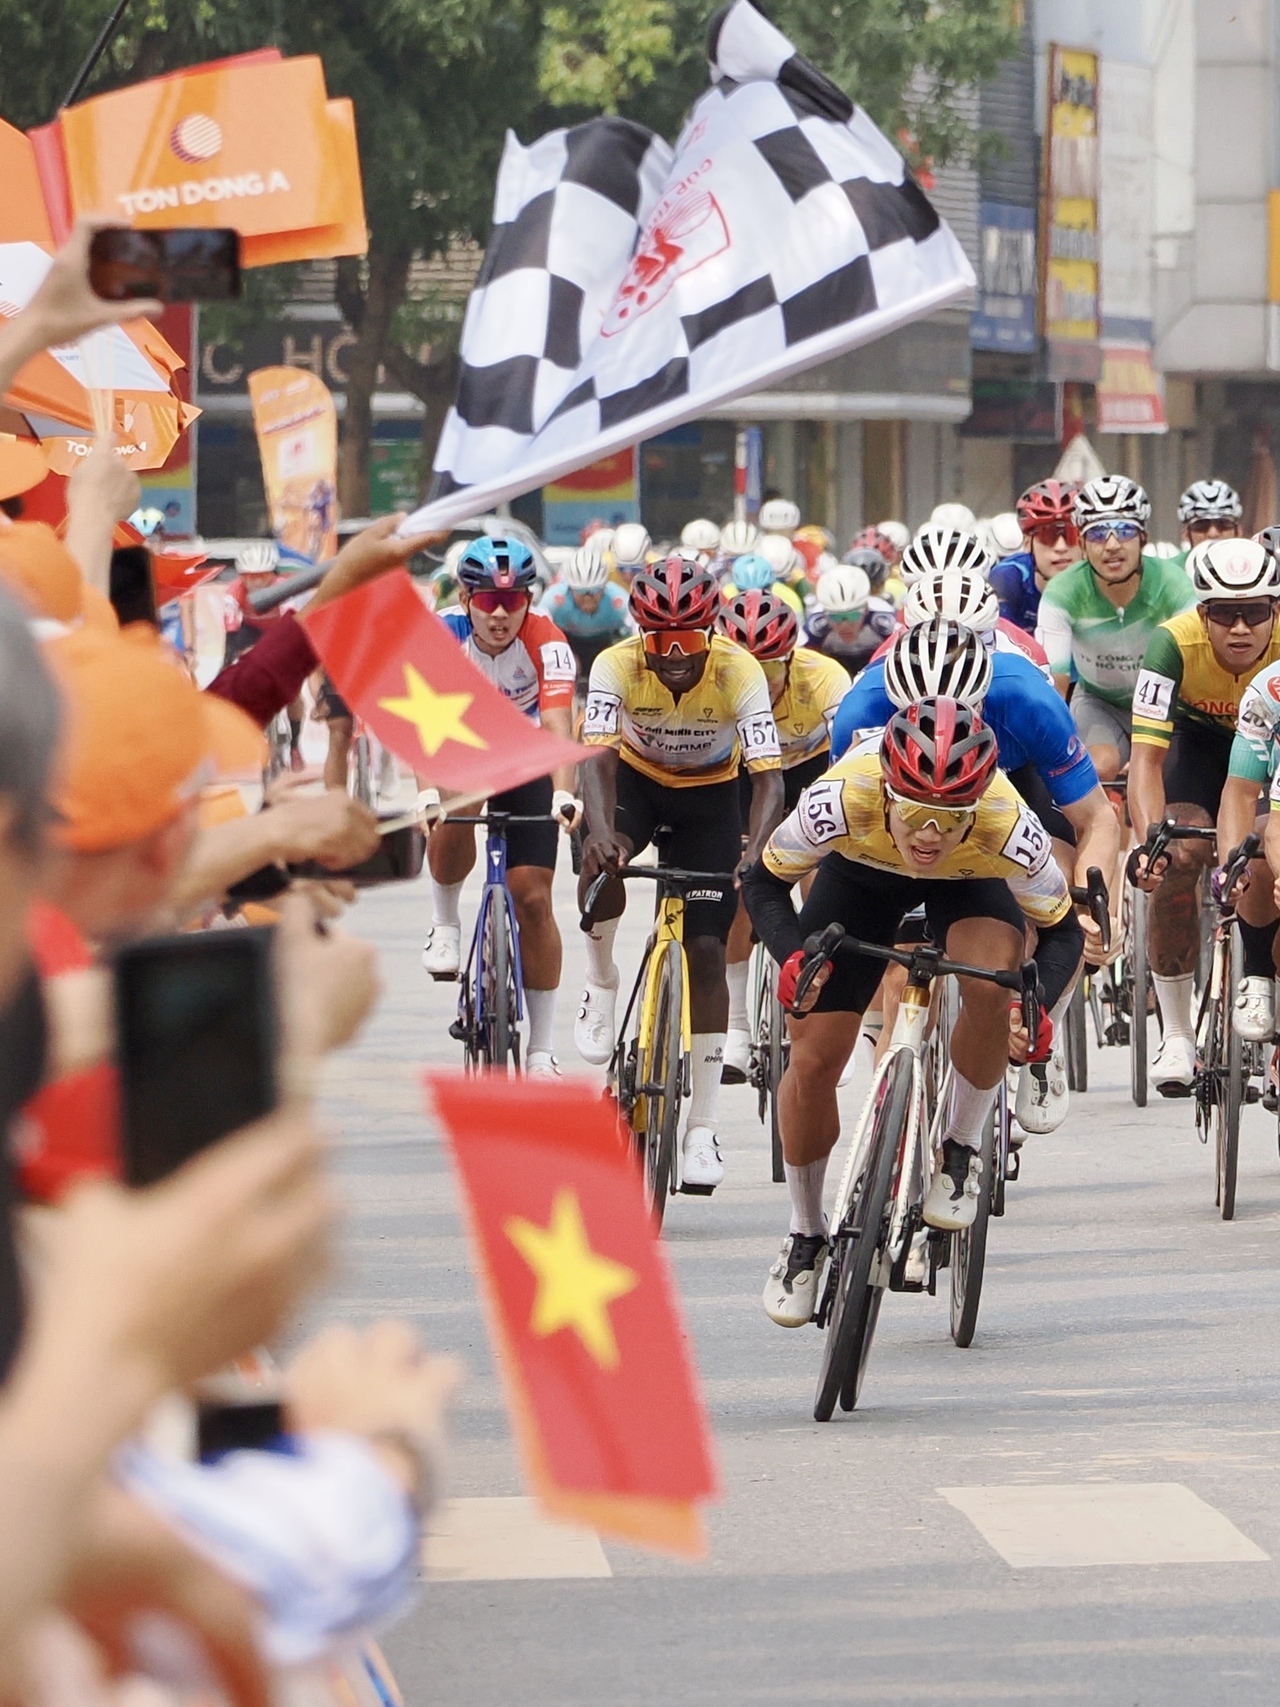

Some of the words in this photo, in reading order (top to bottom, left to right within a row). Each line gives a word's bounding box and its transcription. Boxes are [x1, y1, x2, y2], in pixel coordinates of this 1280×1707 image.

[118, 186, 180, 216] TON
[181, 172, 265, 206] DONG
[268, 168, 292, 194] A
[553, 649, 572, 670] 14
[1138, 680, 1161, 706] 41
[743, 721, 775, 748] 157
[808, 785, 836, 837] 156
